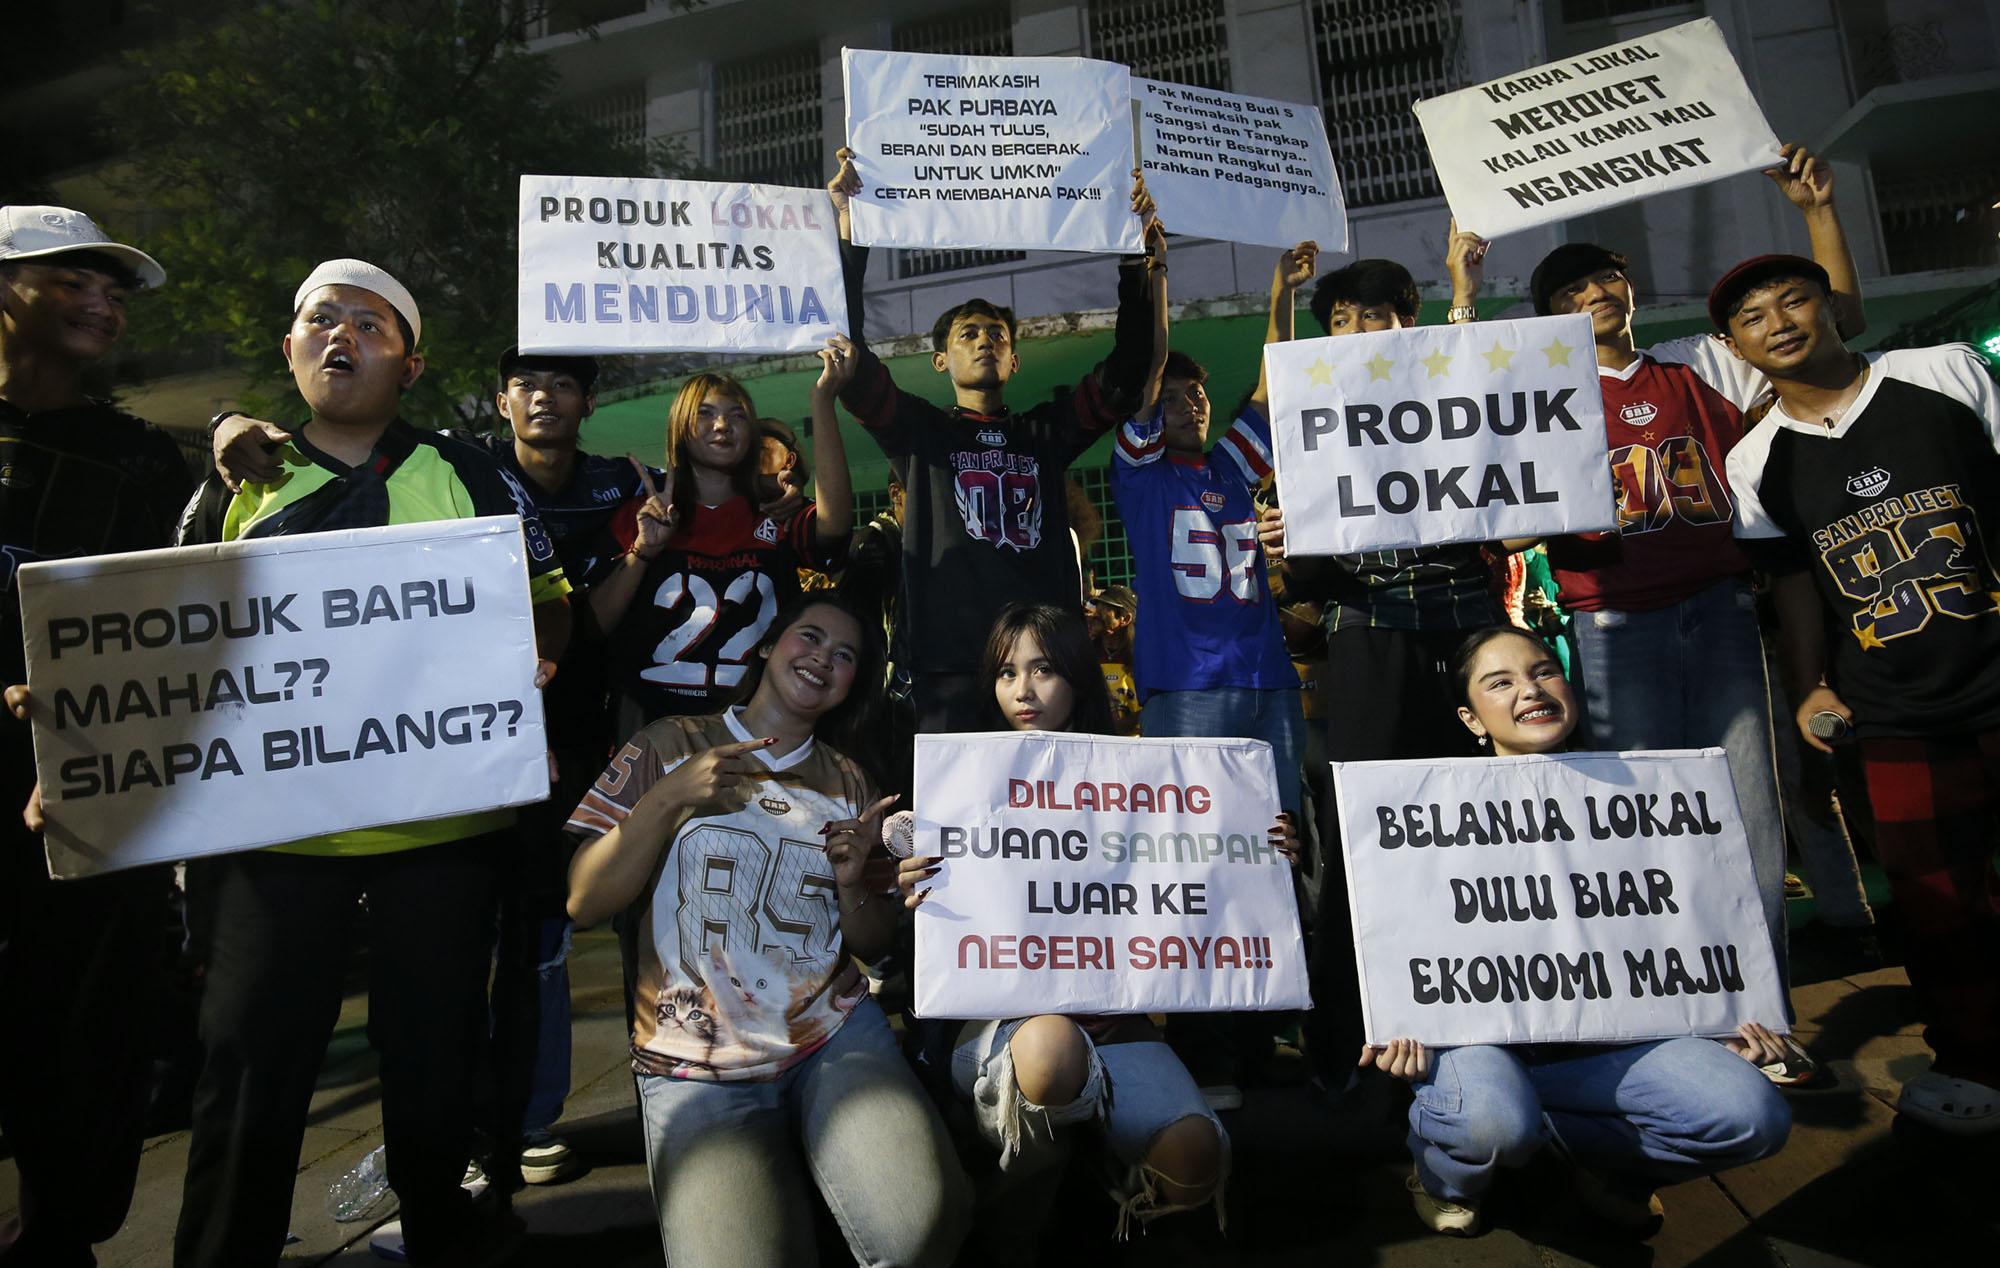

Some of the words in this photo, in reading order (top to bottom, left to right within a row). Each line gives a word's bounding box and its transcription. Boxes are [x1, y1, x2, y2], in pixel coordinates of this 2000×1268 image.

[924, 74, 1040, 89] TERIMAKASIH
[1480, 69, 1574, 104] KARYA
[1572, 45, 1660, 76] LOKAL
[908, 98, 952, 116] PAK
[960, 98, 1058, 116] PURBAYA
[1146, 84, 1176, 99] Pak
[1181, 90, 1242, 112] Mendag
[1246, 102, 1280, 116] Budi
[1284, 108, 1294, 118] S
[1163, 100, 1250, 125] Terimaksih
[1254, 117, 1282, 130] pak
[1490, 74, 1670, 140] MEROKET
[919, 123, 985, 137] "SUDAH
[990, 123, 1050, 138] TULUS,
[1156, 128, 1222, 148] Importir
[1226, 139, 1307, 162] Besarnya..
[1212, 124, 1240, 137] dan
[1244, 129, 1309, 149] Tangkap
[1482, 140, 1570, 174] KALAU
[1571, 115, 1652, 150] KAMU
[1649, 101, 1717, 128] MAU
[881, 143, 945, 156] BERANI
[950, 143, 986, 157] DAN
[992, 143, 1090, 156] BERGERAK..
[1156, 143, 1213, 162] Namun
[1218, 153, 1280, 173] Rangkul
[1285, 165, 1313, 178] dan
[914, 165, 984, 181] UNTUK
[990, 164, 1062, 180] UMKM"
[1143, 160, 1210, 178] arahkan
[1214, 168, 1326, 196] Pedagangnya..
[1503, 137, 1713, 209] NGANGKAT
[540, 196, 692, 226] PRODUK
[711, 201, 821, 230] LOKAL
[874, 187, 931, 200] CETAR
[936, 187, 1052, 201] MEMBAHANA
[1056, 187, 1102, 200] PAK!!!
[597, 241, 775, 271] KUALITAS
[544, 282, 830, 325] MENDUNIA
[1301, 387, 1582, 452] PRODUK
[1337, 461, 1560, 518] LOKAL
[1858, 484, 1965, 531] PROJECT
[1812, 513, 1864, 552] SAN
[47, 593, 302, 660] PRODUK
[323, 576, 476, 628] BARU
[640, 571, 779, 687] 22
[54, 658, 330, 730] MAHAL??
[60, 738, 244, 801] SIAPA
[263, 700, 524, 773] BILANG??
[595, 742, 642, 796] 5
[1008, 778, 1211, 815] DILARANG
[1376, 798, 1575, 850] BELANJA
[1585, 791, 1722, 840] LOKAL
[940, 827, 1088, 861] BUANG
[1101, 831, 1278, 865] SAMPAH
[676, 823, 840, 987] 85
[1027, 881, 1138, 915] LUAR
[1152, 883, 1208, 915] KE
[1450, 874, 1558, 924] DULU
[1569, 868, 1679, 918] BIAR
[957, 934, 1115, 970] NEGERI
[1128, 936, 1273, 970] SAYA!!!
[1409, 951, 1612, 1004] EKONOMI
[1623, 944, 1745, 998] MAJU
